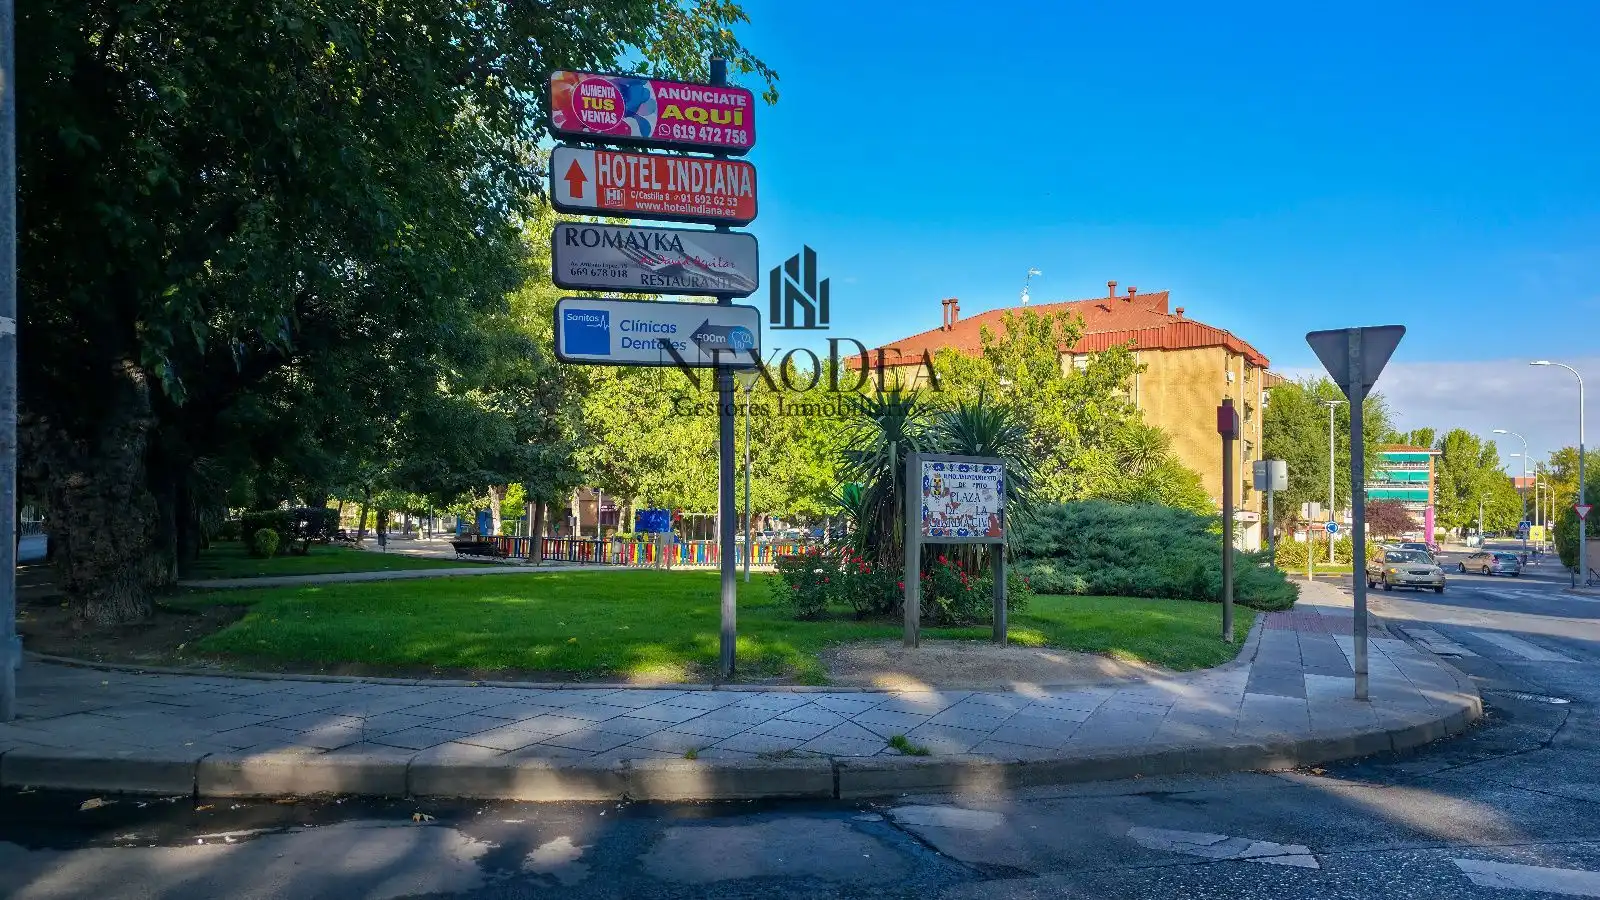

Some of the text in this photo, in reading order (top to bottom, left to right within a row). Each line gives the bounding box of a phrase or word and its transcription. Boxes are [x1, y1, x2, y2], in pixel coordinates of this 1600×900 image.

[580, 84, 616, 98] AUMENTA
[657, 87, 747, 106] ANÚNCIATE
[583, 97, 615, 111] TUS
[581, 109, 617, 125] VENTAS
[661, 104, 744, 126] AQUÍ
[673, 124, 747, 145] 619 472 758
[597, 153, 753, 198] HOTEL INDIANA
[630, 190, 664, 201] C/Castilla
[680, 193, 691, 204] 91
[694, 194, 711, 205] 692
[714, 196, 724, 206] 62
[727, 197, 738, 207] 53
[635, 201, 736, 217] www.hotelindiana.es
[565, 227, 685, 253] ROMAYKA
[571, 267, 628, 278] 669 678 018
[641, 273, 733, 289] RESTAURANTE
[567, 313, 600, 323] Sanitas
[619, 319, 677, 334] Clínicas
[621, 337, 687, 352] Dentales
[697, 333, 726, 343] 500m
[950, 491, 981, 503] PLAZA
[975, 505, 988, 516] LA
